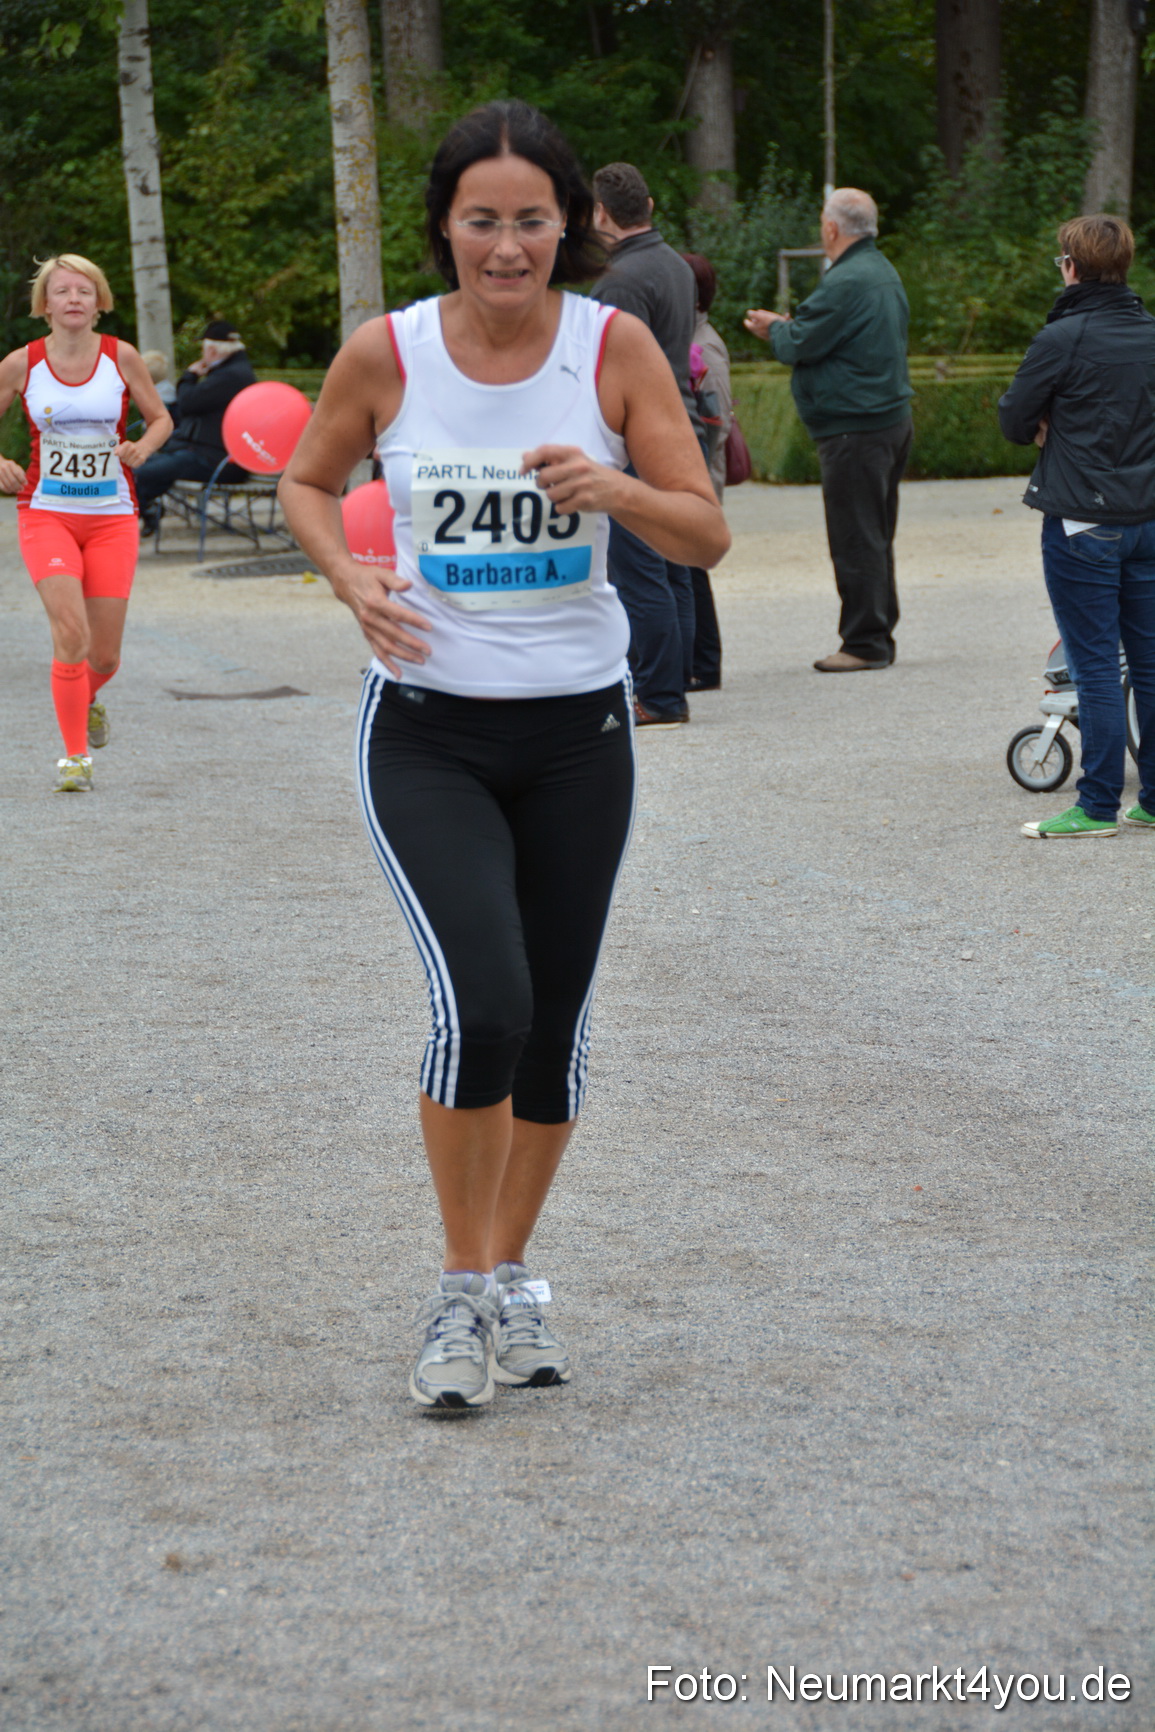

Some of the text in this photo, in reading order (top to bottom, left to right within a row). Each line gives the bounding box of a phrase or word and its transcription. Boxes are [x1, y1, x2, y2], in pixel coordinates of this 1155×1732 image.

[42, 438, 106, 450] PARTL Neumarkt
[49, 451, 111, 478] 2437
[417, 464, 477, 480] PARTL
[60, 483, 100, 496] Claudia
[433, 489, 581, 545] 2405
[446, 558, 567, 586] Barbara A.
